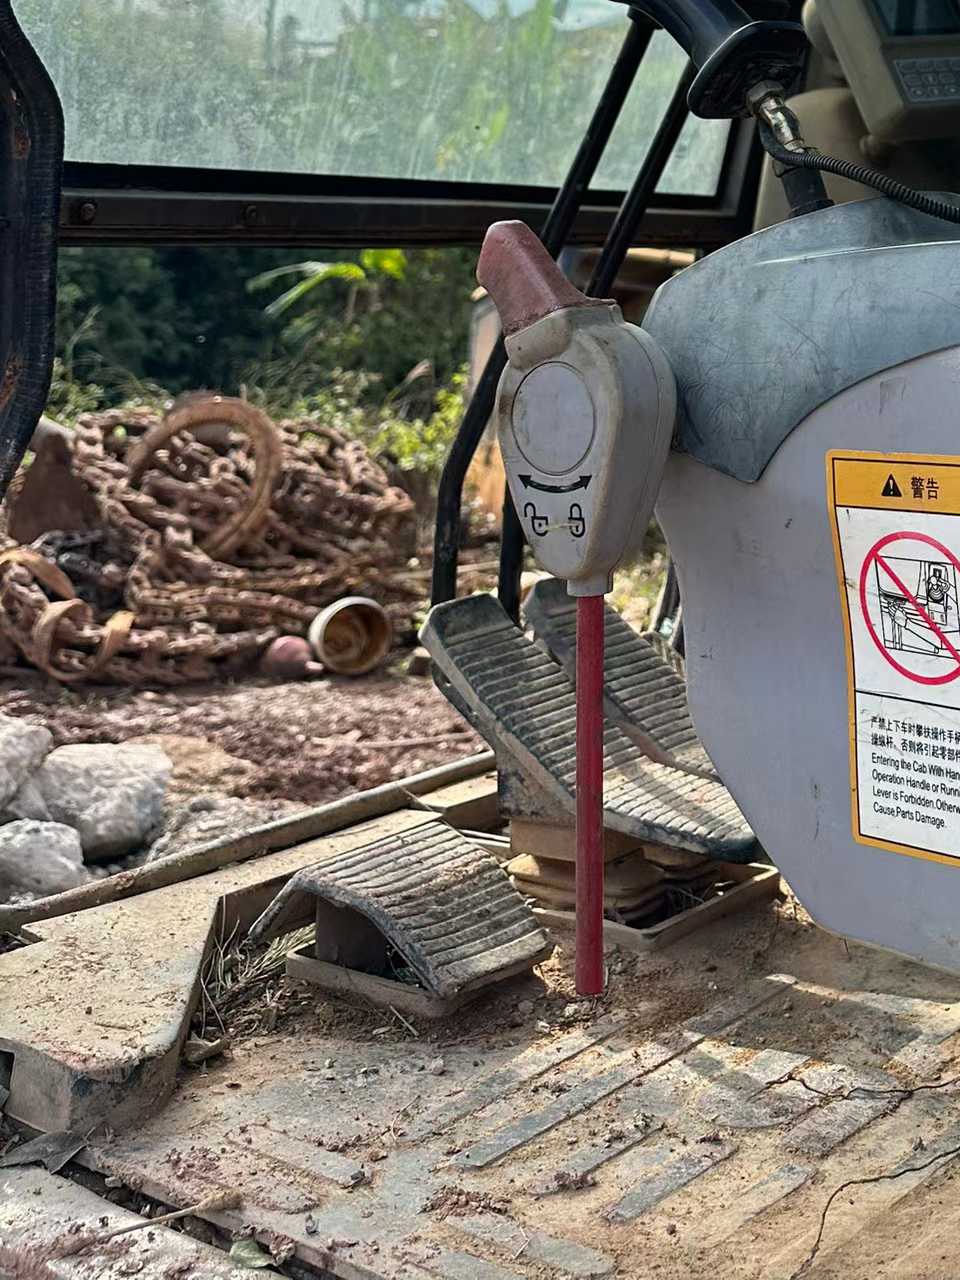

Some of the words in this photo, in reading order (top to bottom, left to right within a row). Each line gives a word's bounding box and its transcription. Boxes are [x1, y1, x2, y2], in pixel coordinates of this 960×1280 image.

[911, 476, 939, 500] 警告
[872, 752, 899, 771] Entering
[900, 759, 912, 771] the
[912, 760, 927, 774] Cab
[928, 764, 945, 777] With
[872, 769, 905, 785] Operation
[906, 775, 930, 792] Handle
[931, 783, 940, 793] or
[872, 785, 891, 799] Lever
[892, 790, 899, 801] is
[896, 806, 914, 821] Parts
